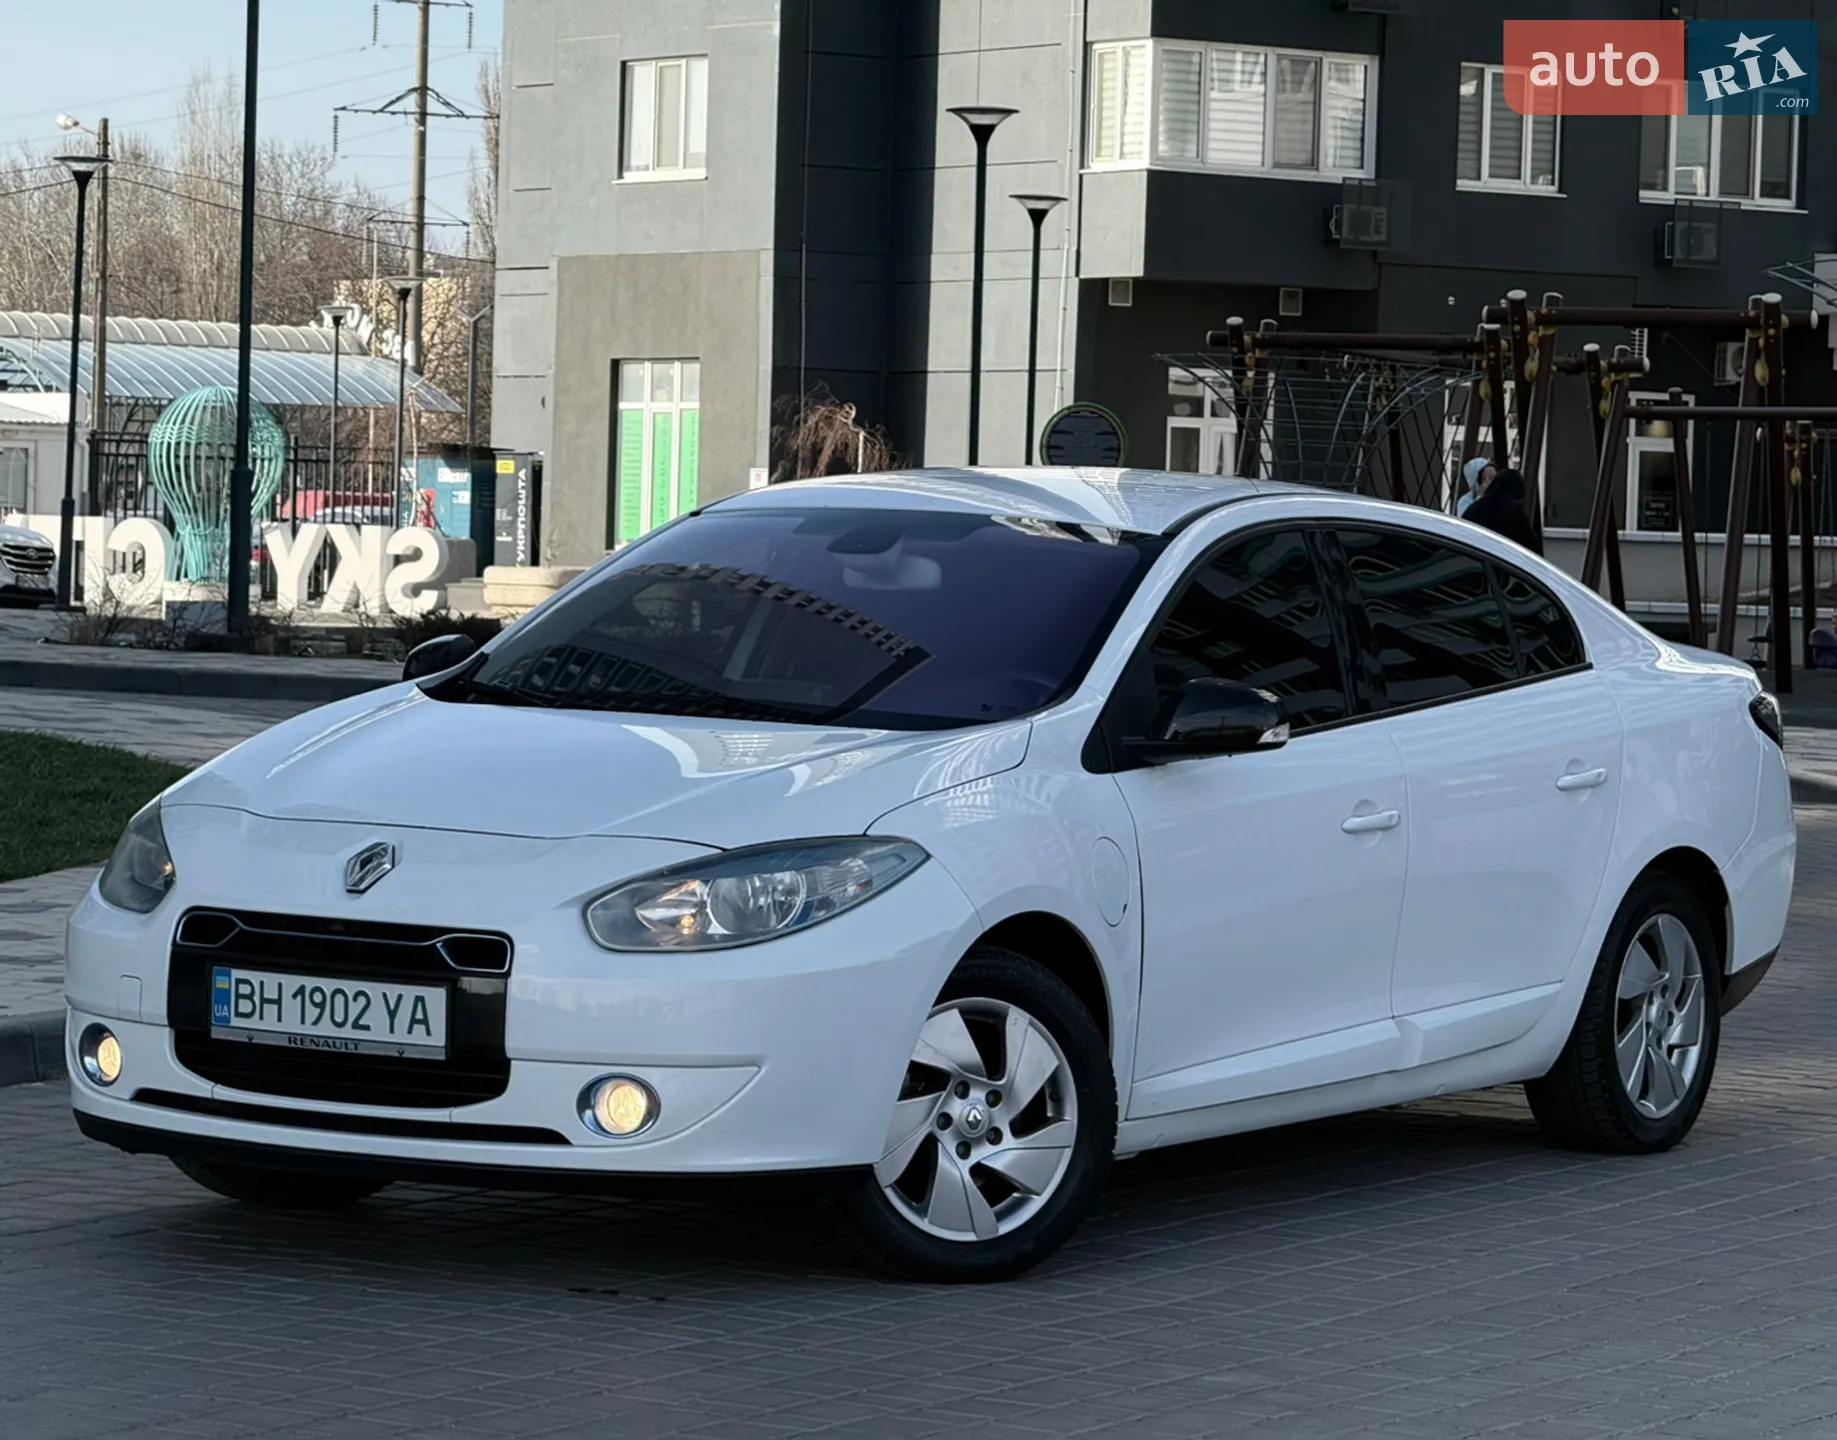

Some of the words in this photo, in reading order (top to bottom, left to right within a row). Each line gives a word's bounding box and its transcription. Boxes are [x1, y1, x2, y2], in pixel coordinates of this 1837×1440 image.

[516, 468, 527, 562] УКРПОШТА
[214, 1004, 229, 1018] UA
[234, 977, 283, 1023] BH
[291, 984, 372, 1031] 1902
[381, 991, 432, 1037] YA
[287, 1035, 362, 1051] RENAULT
